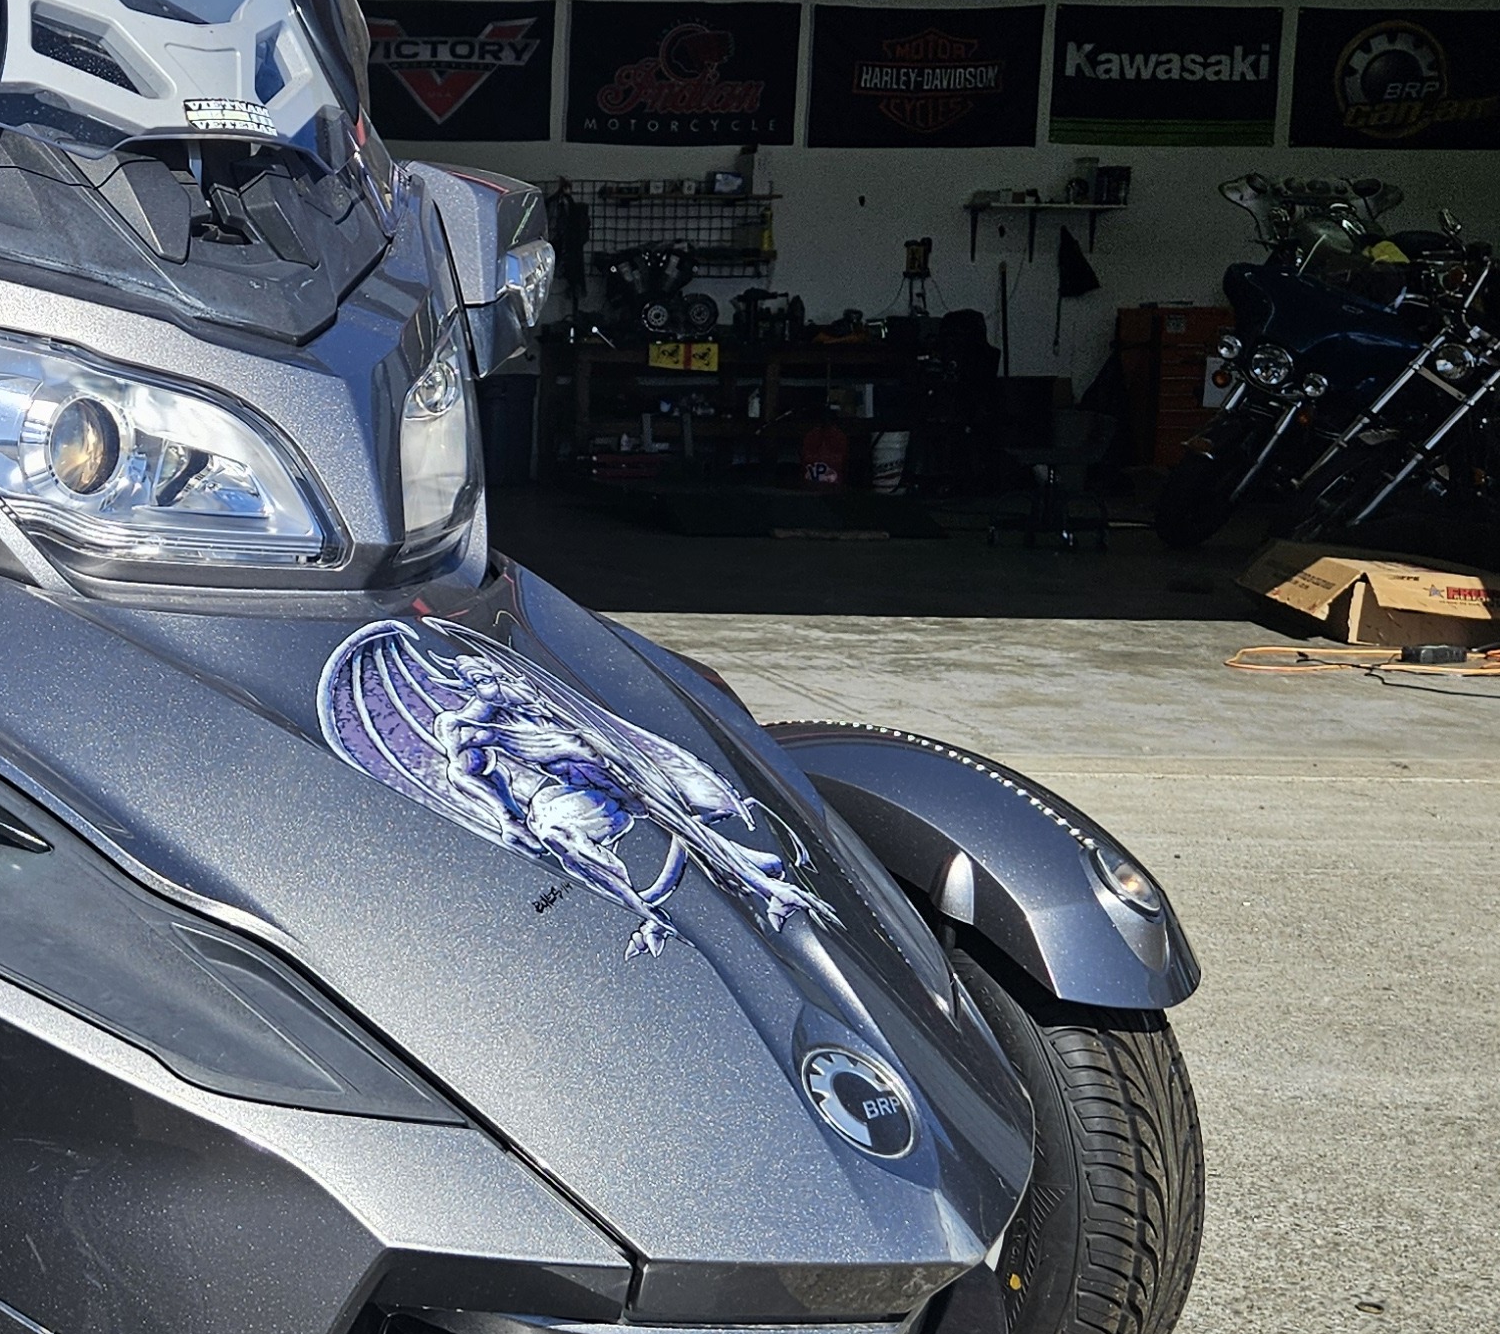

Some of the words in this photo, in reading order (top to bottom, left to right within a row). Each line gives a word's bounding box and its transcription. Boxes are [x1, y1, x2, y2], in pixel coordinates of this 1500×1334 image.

[1064, 41, 1271, 82] Kawasaki
[860, 66, 999, 91] HARLEY-DAVIDSON
[1383, 81, 1440, 99] BRP
[185, 100, 270, 118] VIETNAM
[193, 120, 278, 136] VETERAN
[583, 117, 778, 133] MOTORCYCLE
[863, 1096, 901, 1119] BRP
